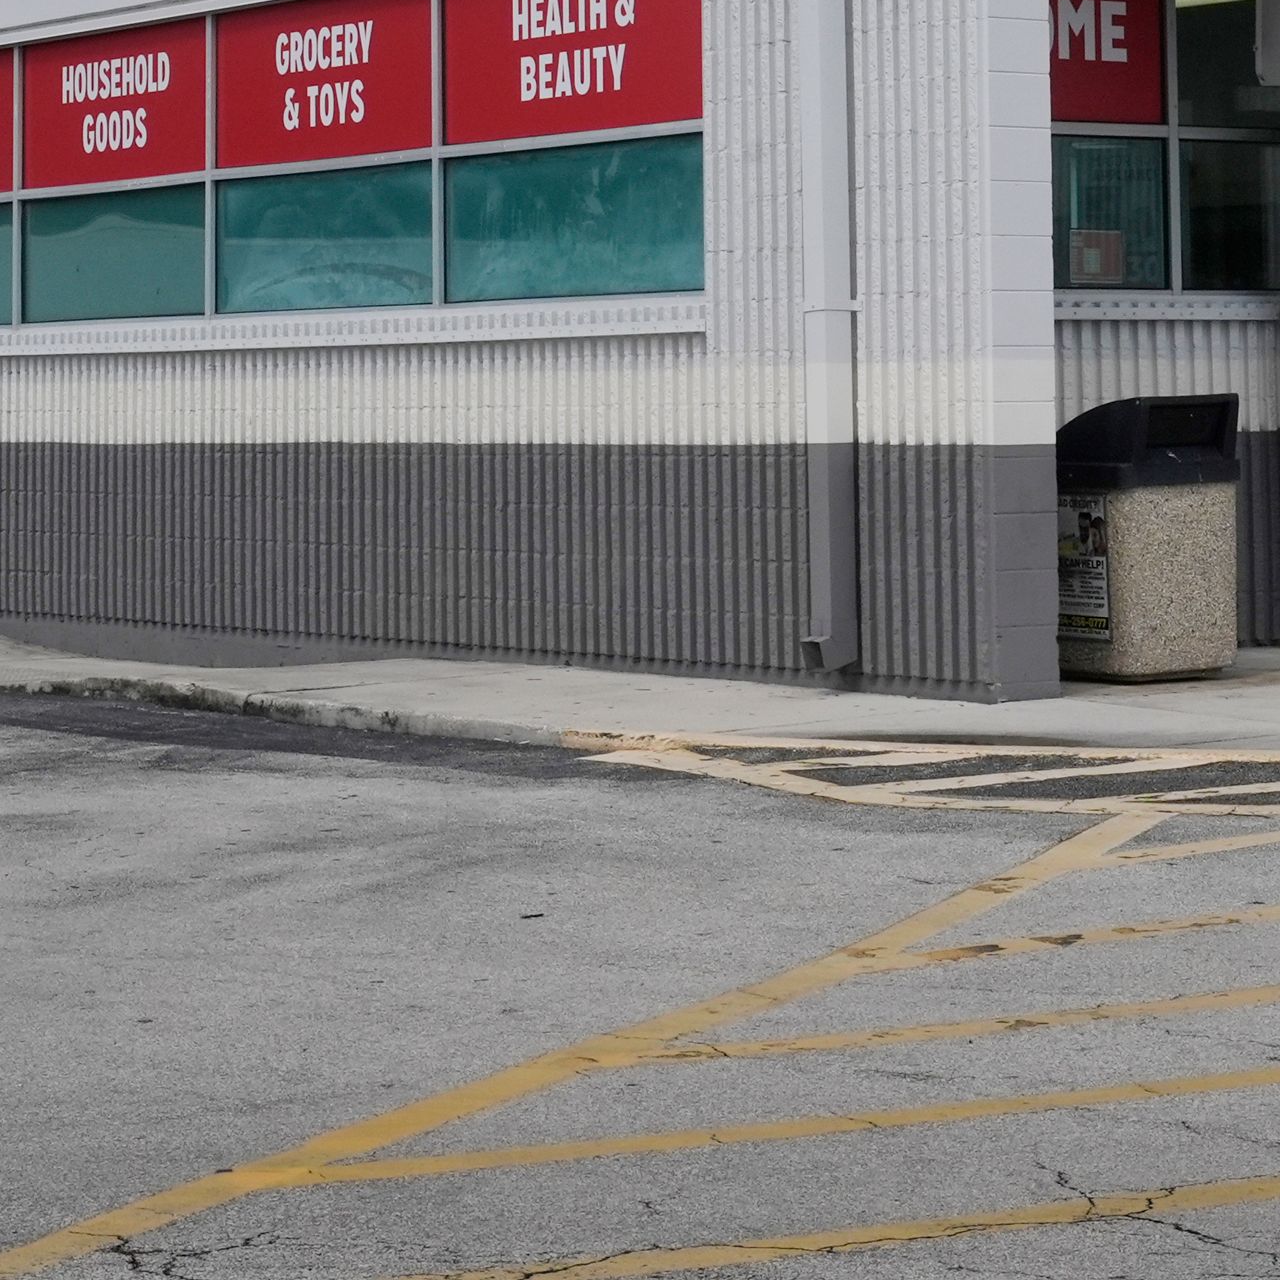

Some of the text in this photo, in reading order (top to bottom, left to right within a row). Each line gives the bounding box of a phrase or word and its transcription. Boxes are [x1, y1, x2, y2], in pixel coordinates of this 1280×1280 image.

[275, 20, 374, 76] GROCERY
[520, 44, 626, 102] BEAUTY
[61, 51, 170, 104] HOUSEHOLD
[82, 107, 147, 154] GOODS
[282, 79, 365, 131] & TOYS
